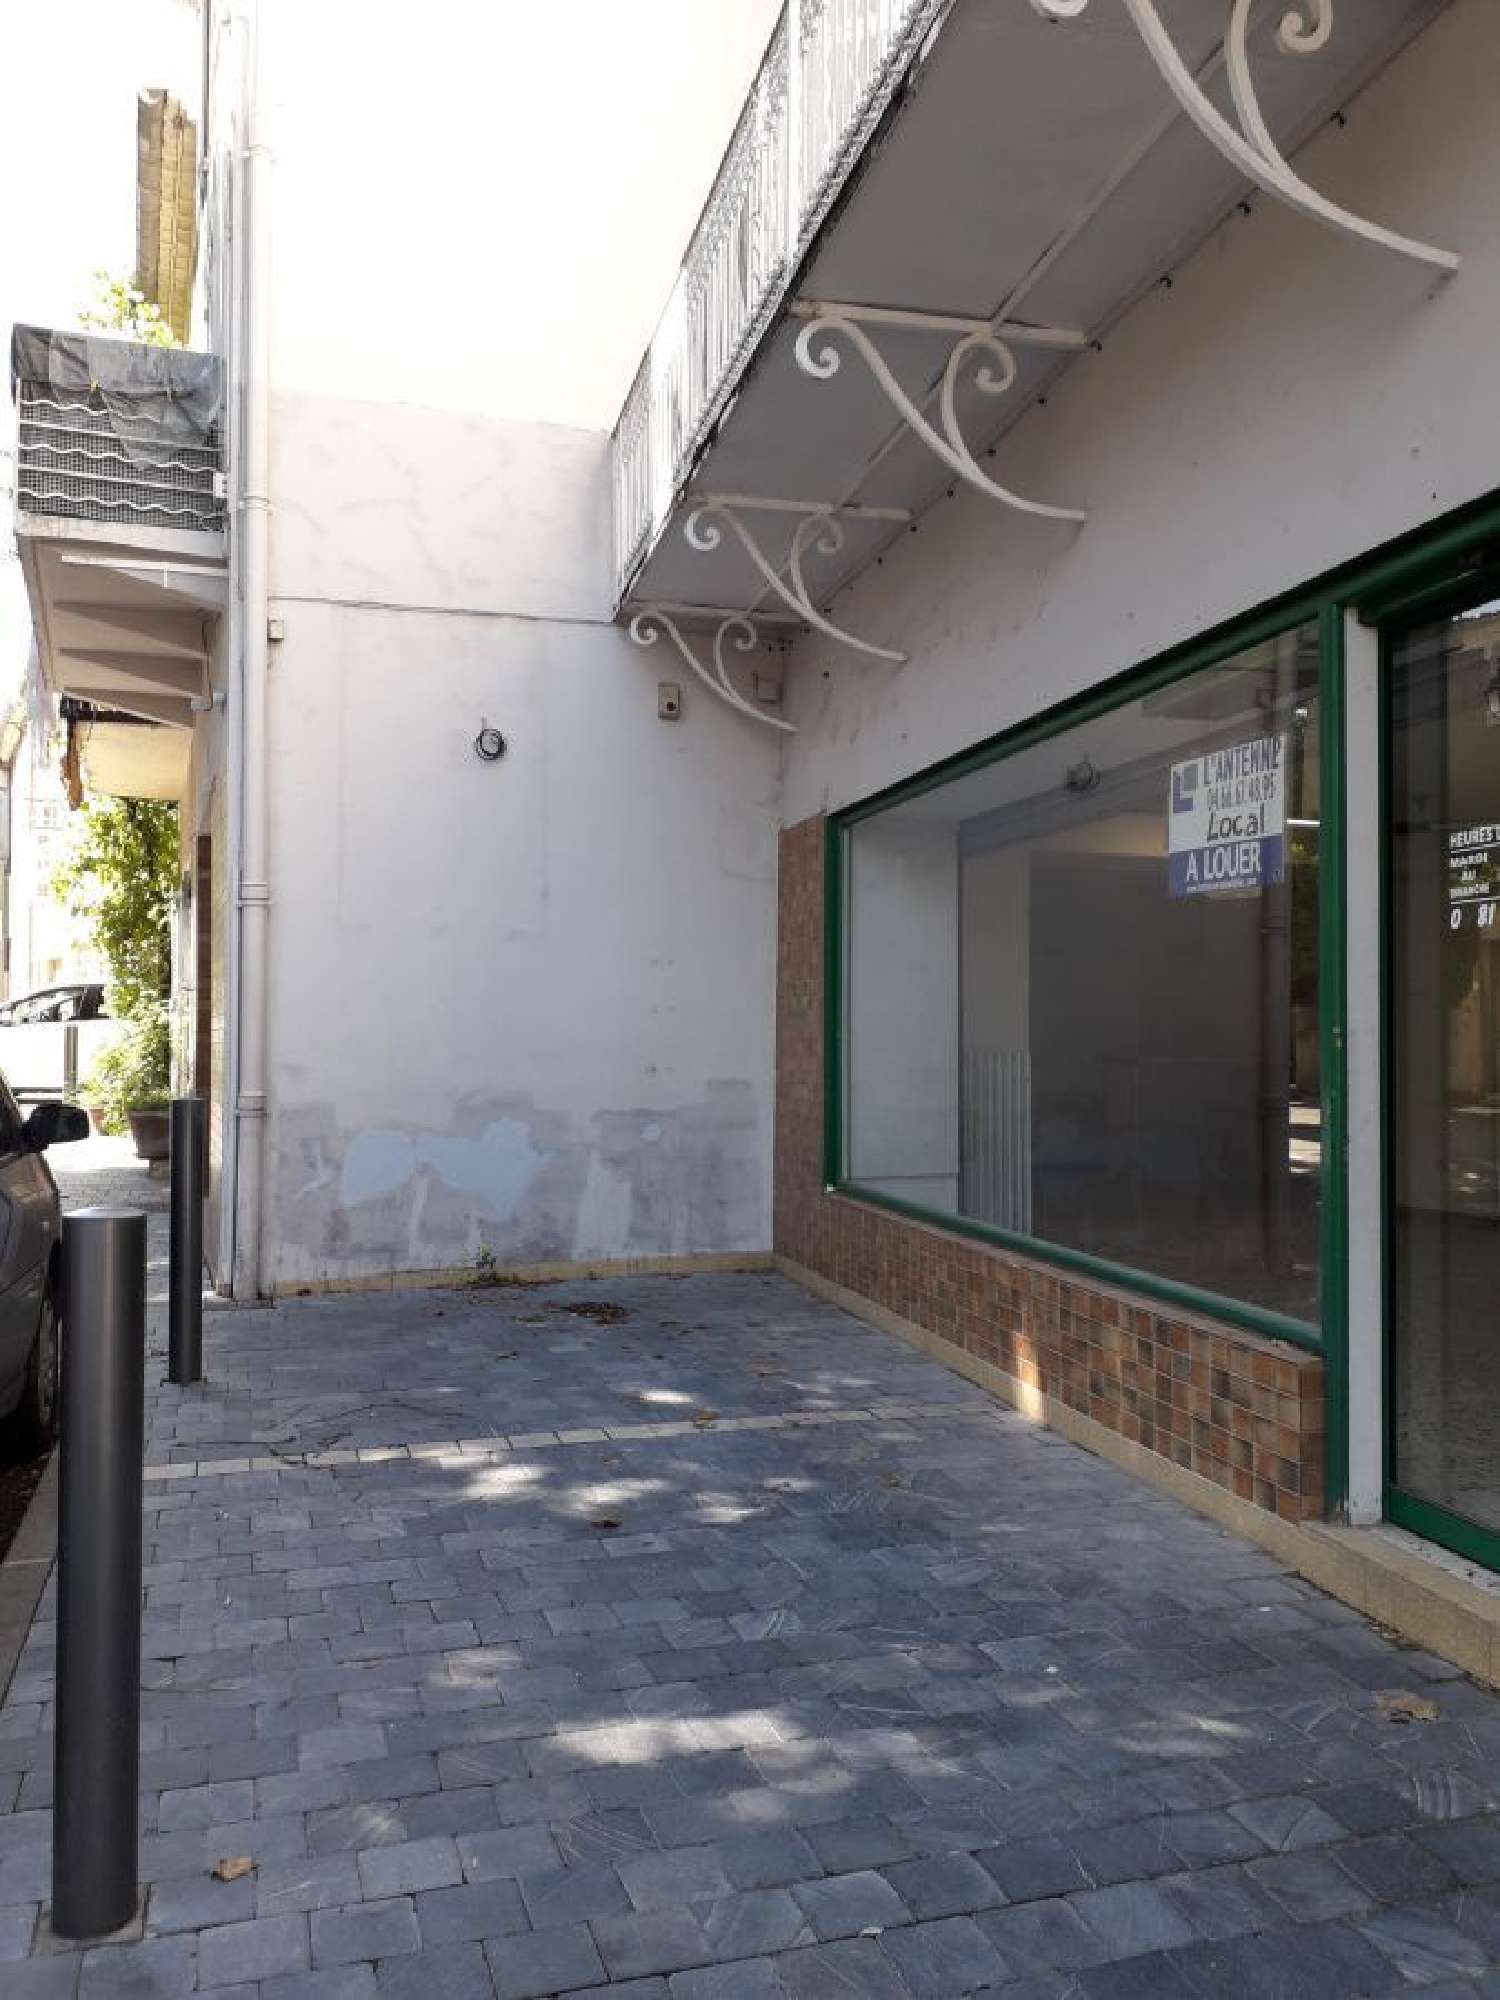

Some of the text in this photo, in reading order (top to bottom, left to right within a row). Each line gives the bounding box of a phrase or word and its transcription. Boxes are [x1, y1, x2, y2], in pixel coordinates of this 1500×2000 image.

[1203, 736, 1281, 785] L'ANTENNE
[1206, 801, 1265, 841] Local
[1186, 841, 1262, 881] A LOUER
